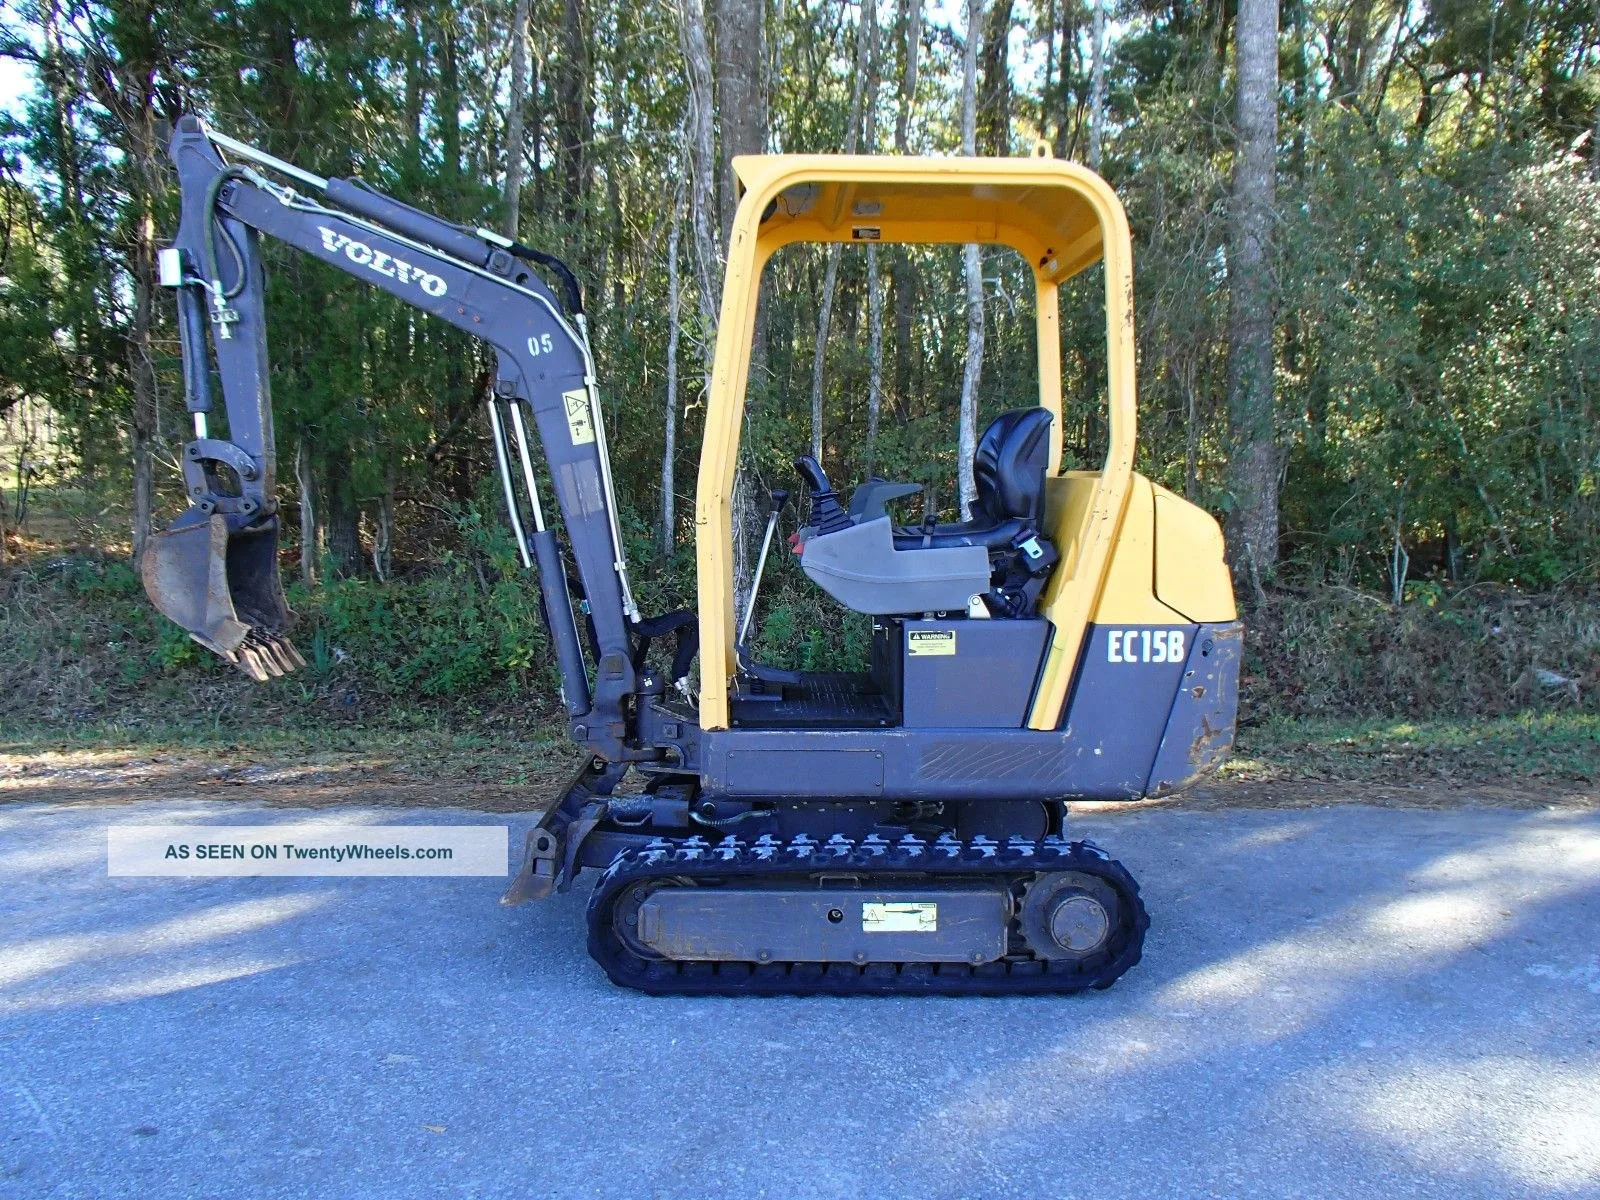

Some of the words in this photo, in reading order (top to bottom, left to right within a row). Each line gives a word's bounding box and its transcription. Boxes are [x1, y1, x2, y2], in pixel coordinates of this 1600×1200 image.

[317, 226, 448, 297] VOLVO
[527, 333, 553, 357] 05
[1107, 630, 1185, 662] EC15B
